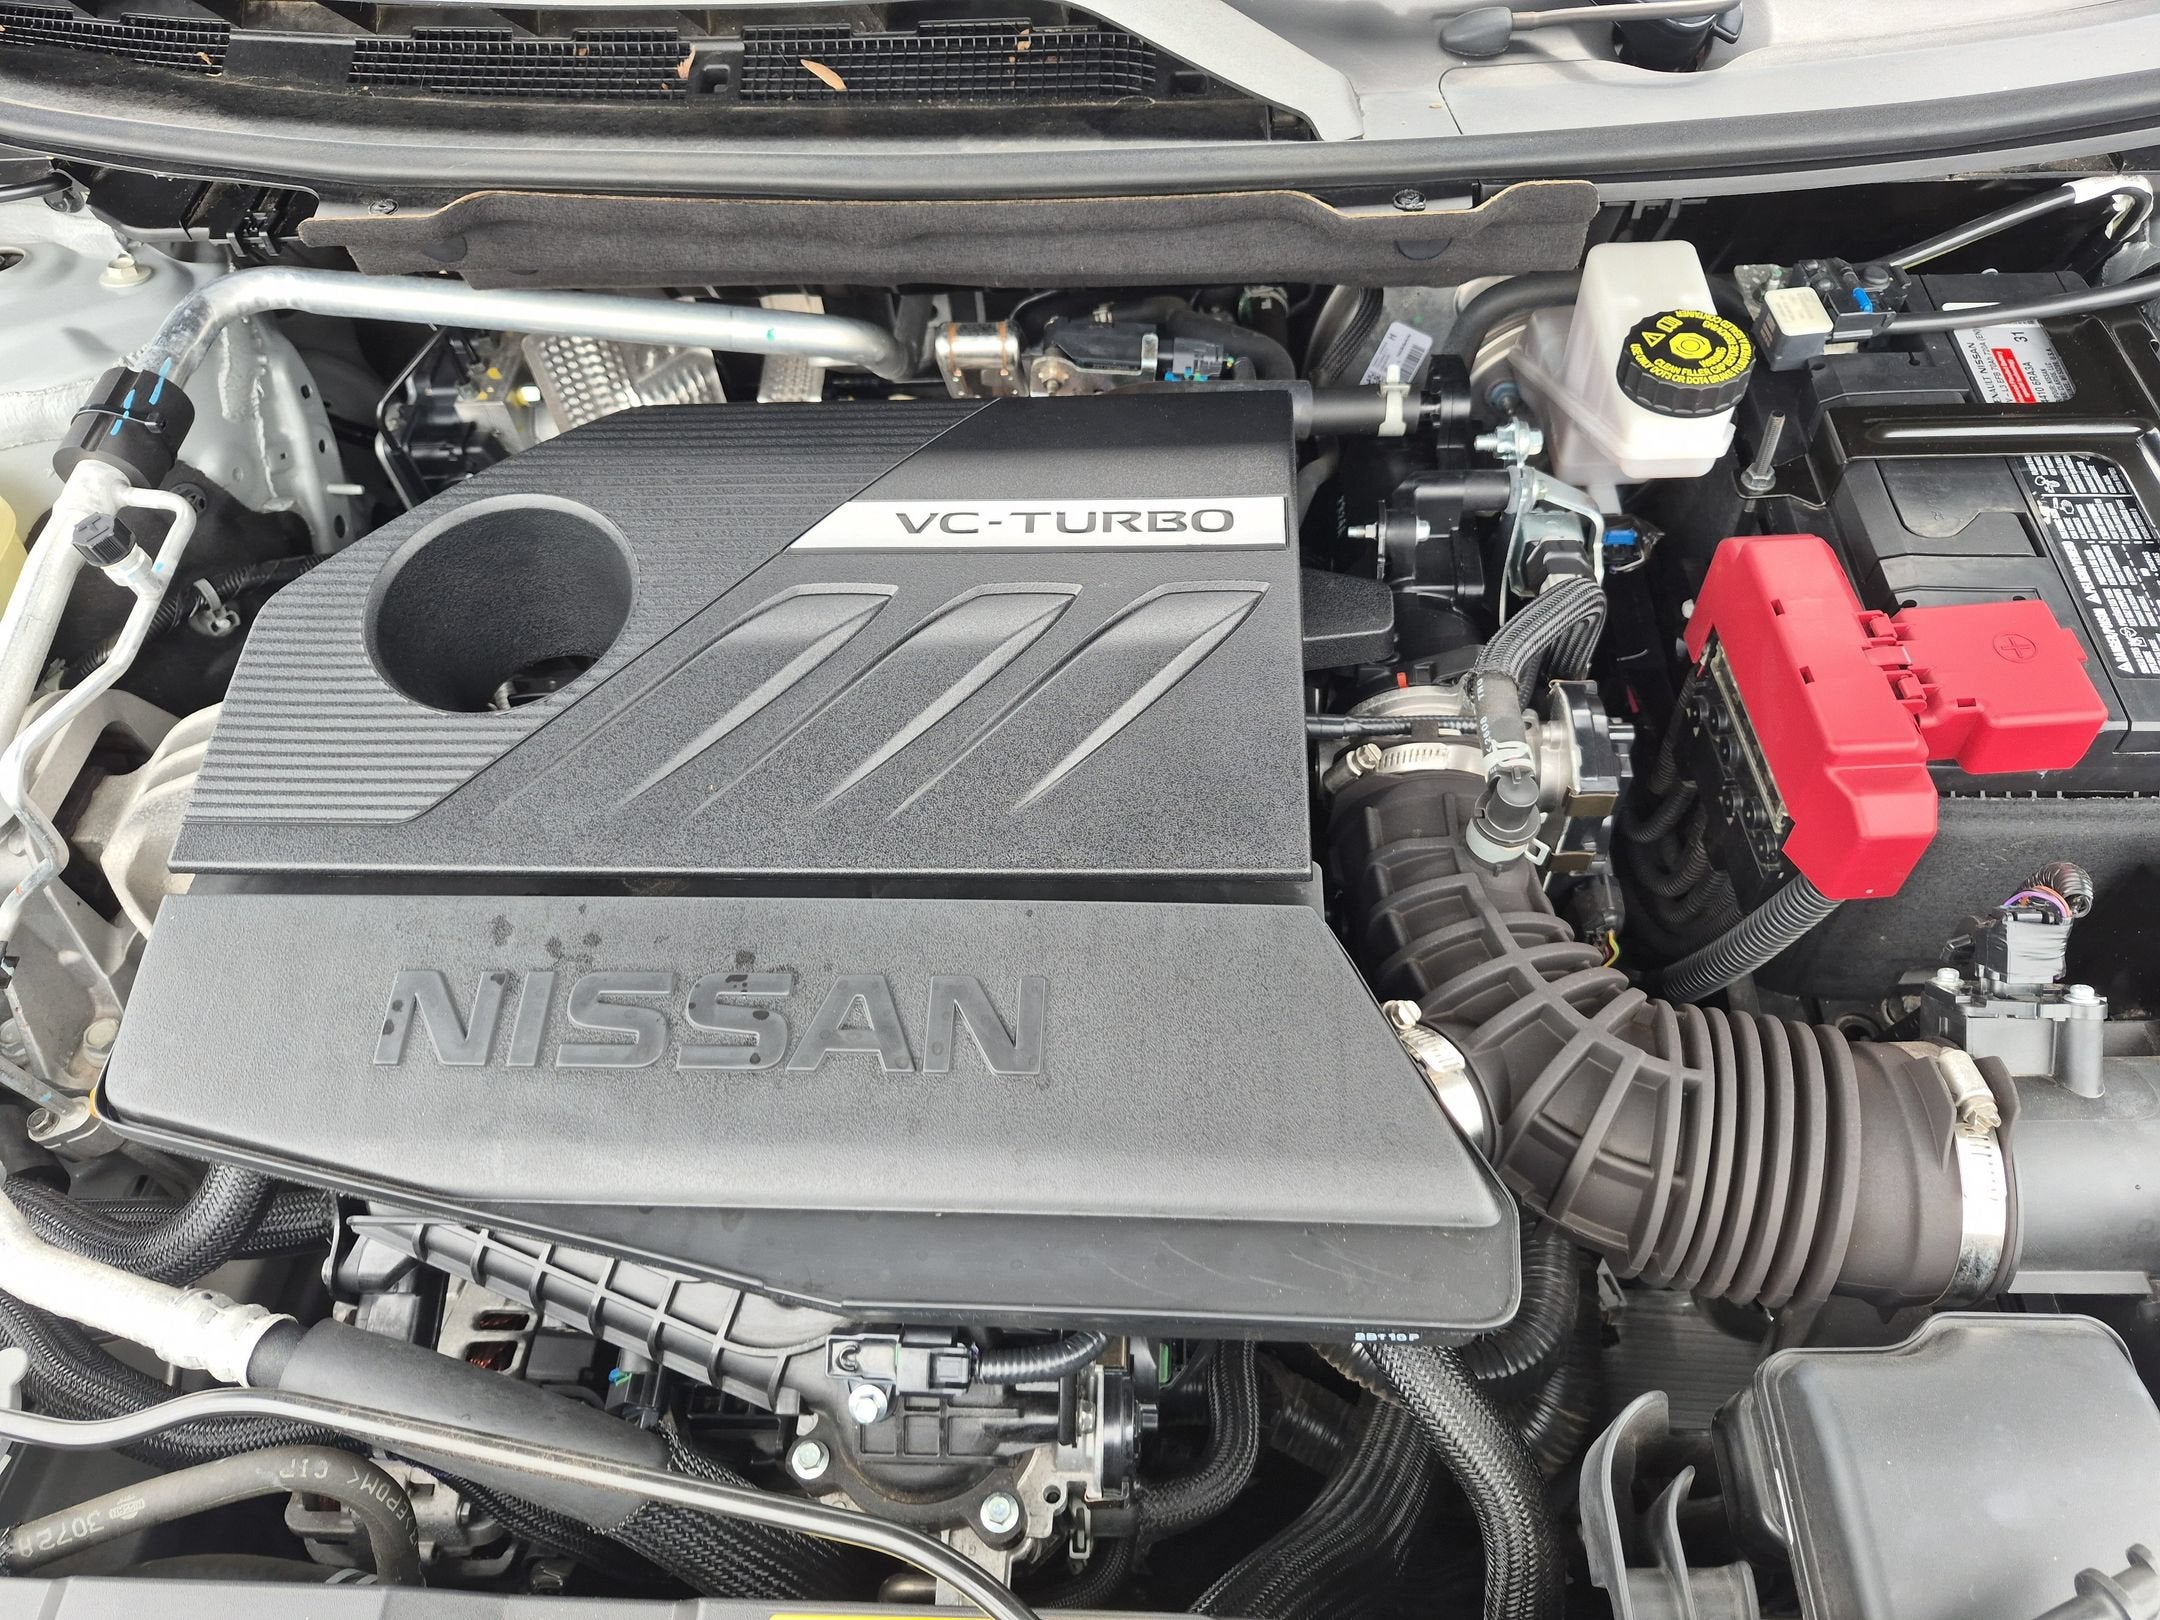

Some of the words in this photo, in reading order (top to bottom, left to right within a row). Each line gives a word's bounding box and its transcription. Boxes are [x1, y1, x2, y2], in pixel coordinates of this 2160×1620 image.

[2011, 330, 2029, 343] 31
[1653, 358, 1682, 375] CLEAN
[1681, 367, 1711, 377] FILLER
[1967, 342, 1988, 374] NISSAN
[1649, 367, 1672, 380] DOT3
[1672, 374, 1686, 384] OR
[1686, 377, 1709, 385] DOT4
[896, 508, 1234, 534] VC-TURBO
[372, 969, 1045, 1075] NISSAN
[18, 1511, 104, 1558] 3072A
